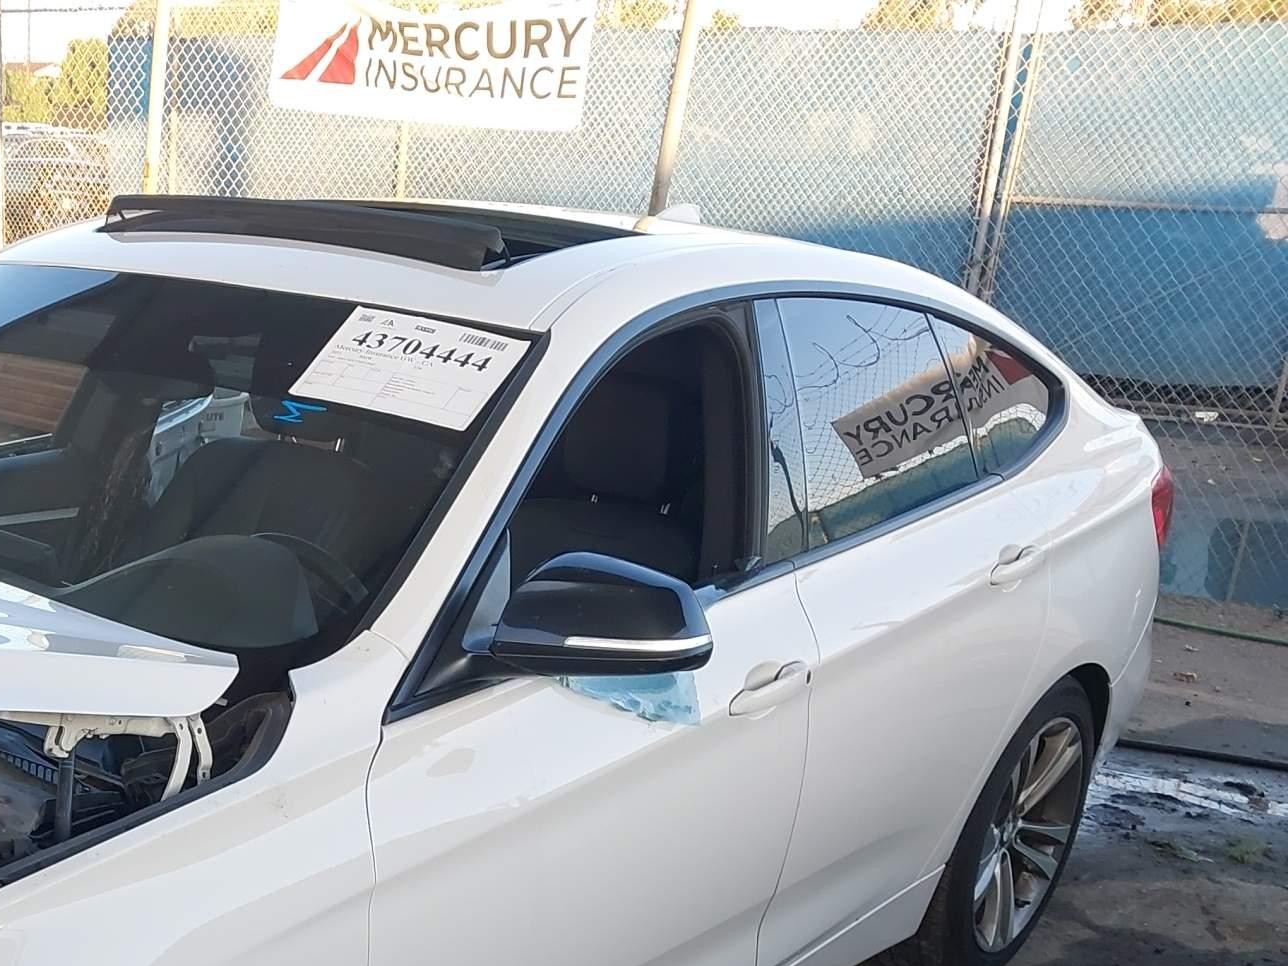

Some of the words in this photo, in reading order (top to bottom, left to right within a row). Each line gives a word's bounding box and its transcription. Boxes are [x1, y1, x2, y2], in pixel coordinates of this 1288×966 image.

[368, 17, 587, 61] MERCURY
[365, 57, 581, 99] INSURANCE
[352, 330, 493, 372] 43704444
